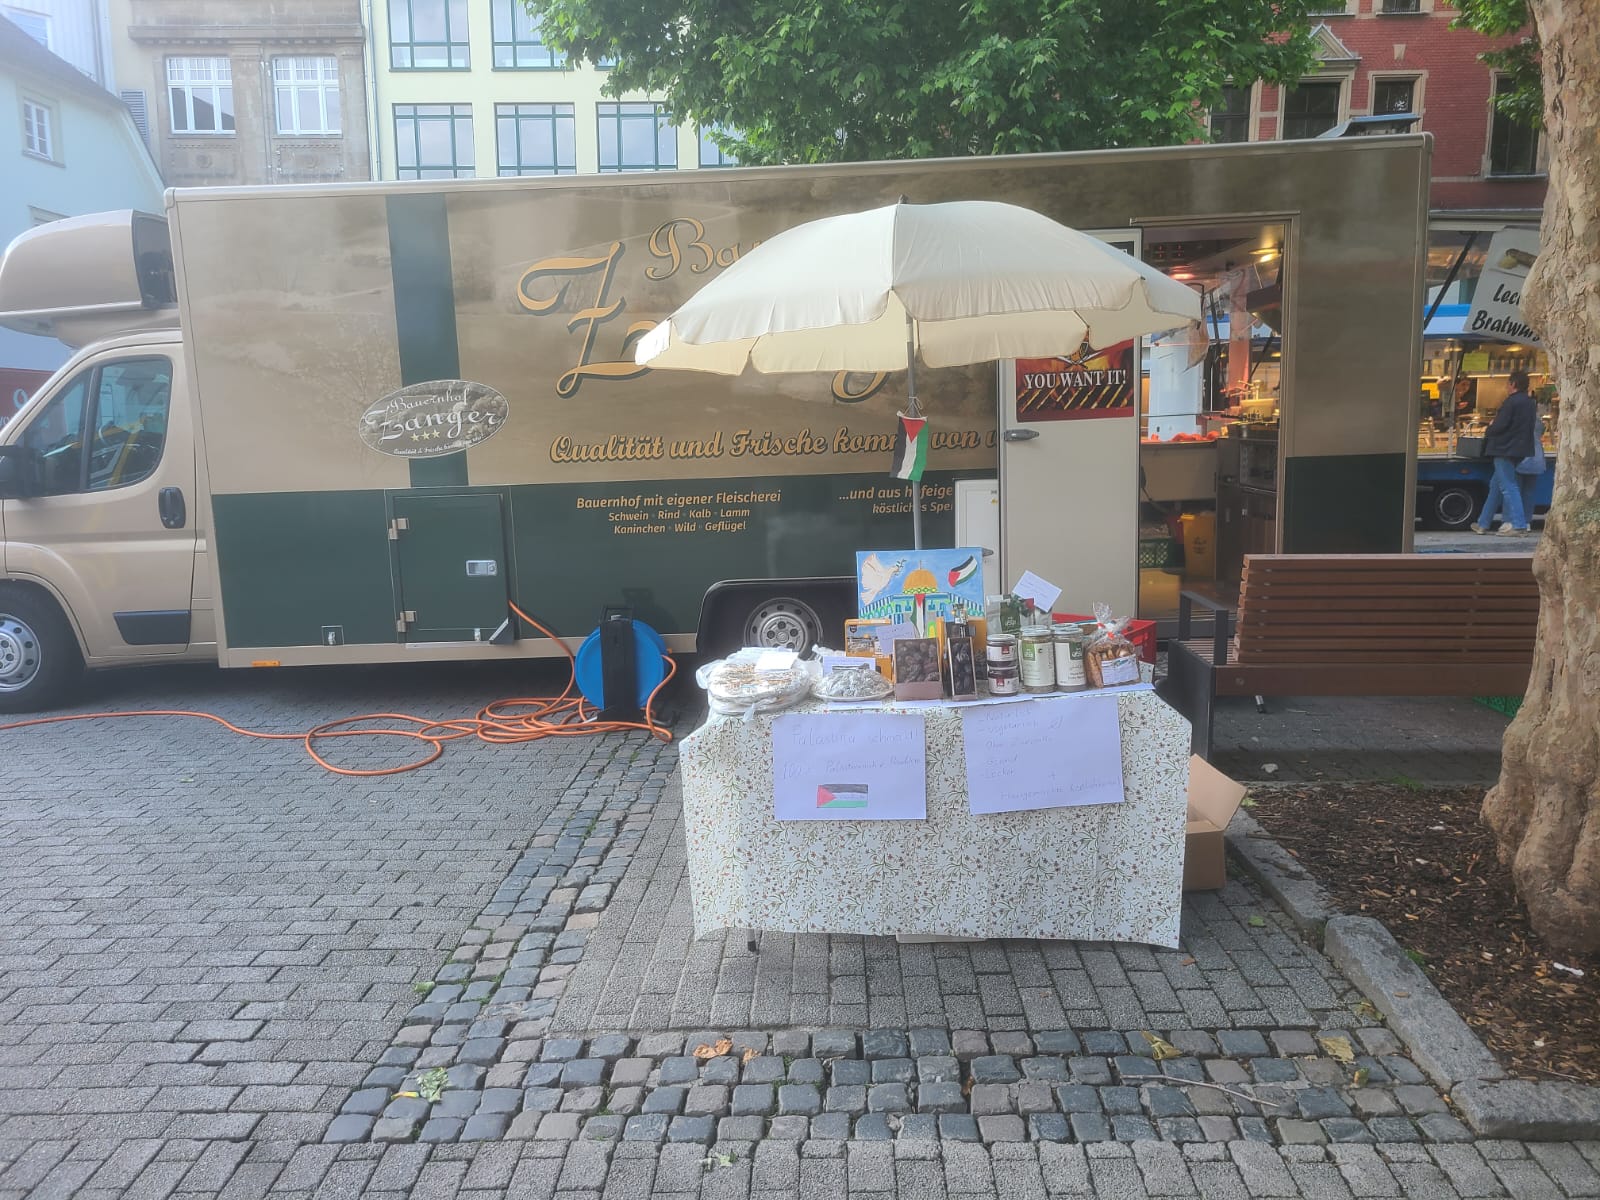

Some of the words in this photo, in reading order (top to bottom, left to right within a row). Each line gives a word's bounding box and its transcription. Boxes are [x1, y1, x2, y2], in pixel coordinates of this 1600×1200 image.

[1024, 373, 1056, 389] YOU
[1060, 370, 1103, 388] WANT
[1107, 369, 1126, 385] IT!
[390, 386, 471, 413] Bauernhof
[364, 404, 505, 445] Zanger
[550, 434, 664, 463] Qualität
[669, 431, 725, 459] und
[729, 427, 828, 457] Frische
[930, 430, 981, 450] von
[576, 495, 641, 509] Bauernhof
[643, 493, 663, 506] mit
[666, 493, 713, 508] eigener
[716, 489, 782, 504] Fleischerei
[878, 488, 901, 498] aus
[608, 511, 649, 522] Schwein
[658, 509, 680, 520] Rind
[689, 509, 711, 519] Kalb
[720, 508, 750, 518] Lamm
[614, 523, 665, 534] Kaninchen
[674, 522, 696, 532] Wild
[705, 520, 746, 533] Geflügel
